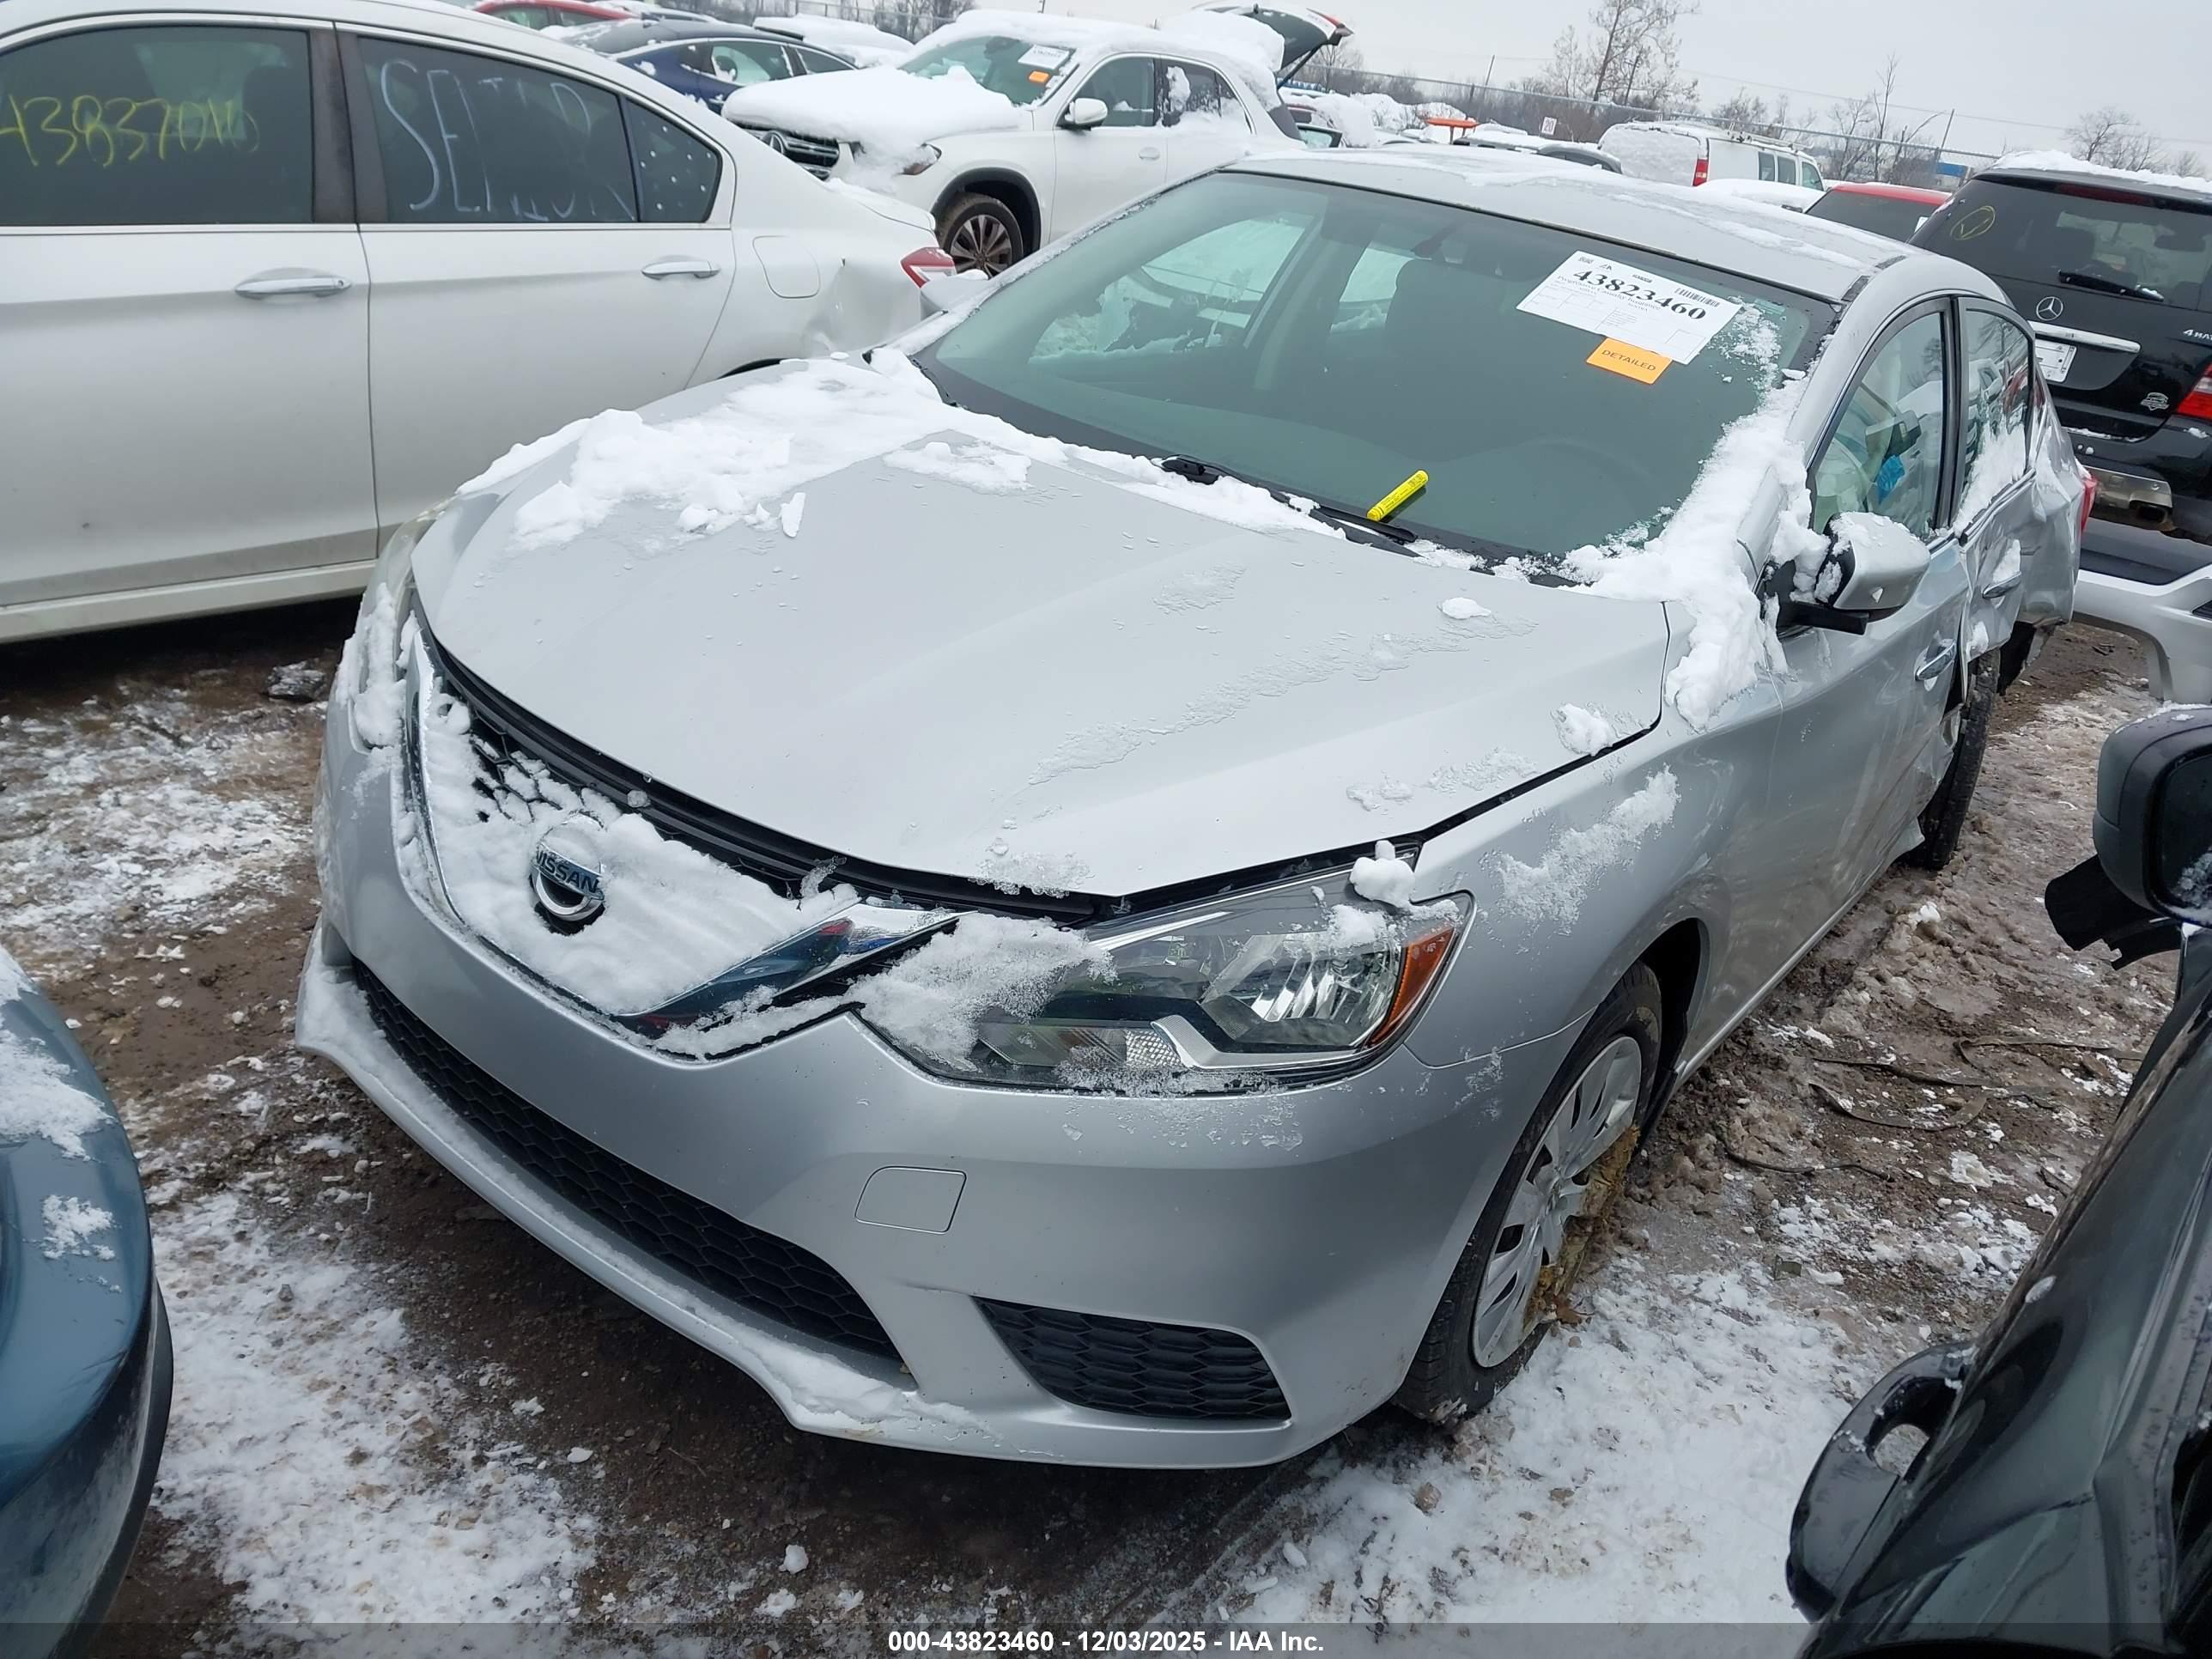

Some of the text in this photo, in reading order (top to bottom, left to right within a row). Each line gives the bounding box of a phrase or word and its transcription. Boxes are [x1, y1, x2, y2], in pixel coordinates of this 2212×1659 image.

[1573, 270, 1707, 320] 43823460
[1601, 349, 1656, 372] DETAILED
[535, 848, 599, 894] NISSAN
